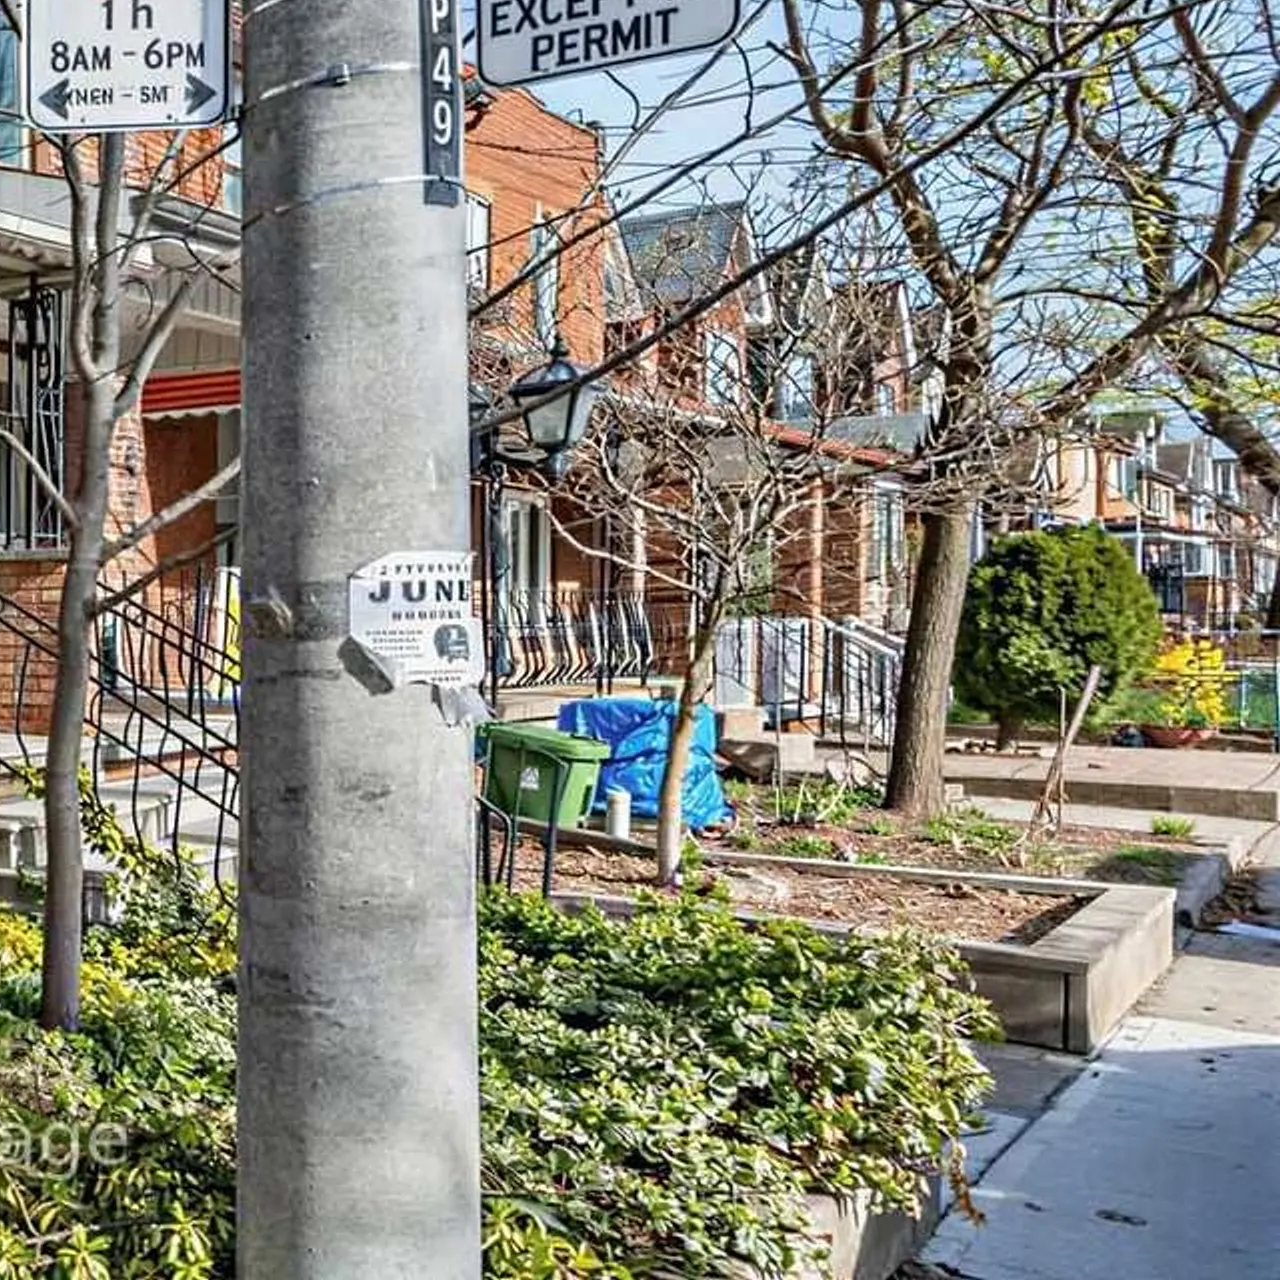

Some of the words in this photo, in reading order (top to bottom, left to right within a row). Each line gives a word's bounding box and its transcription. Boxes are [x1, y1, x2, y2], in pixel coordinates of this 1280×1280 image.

[50, 41, 111, 72] 8AM
[143, 38, 206, 70] 6PM
[531, 8, 679, 72] PERMIT
